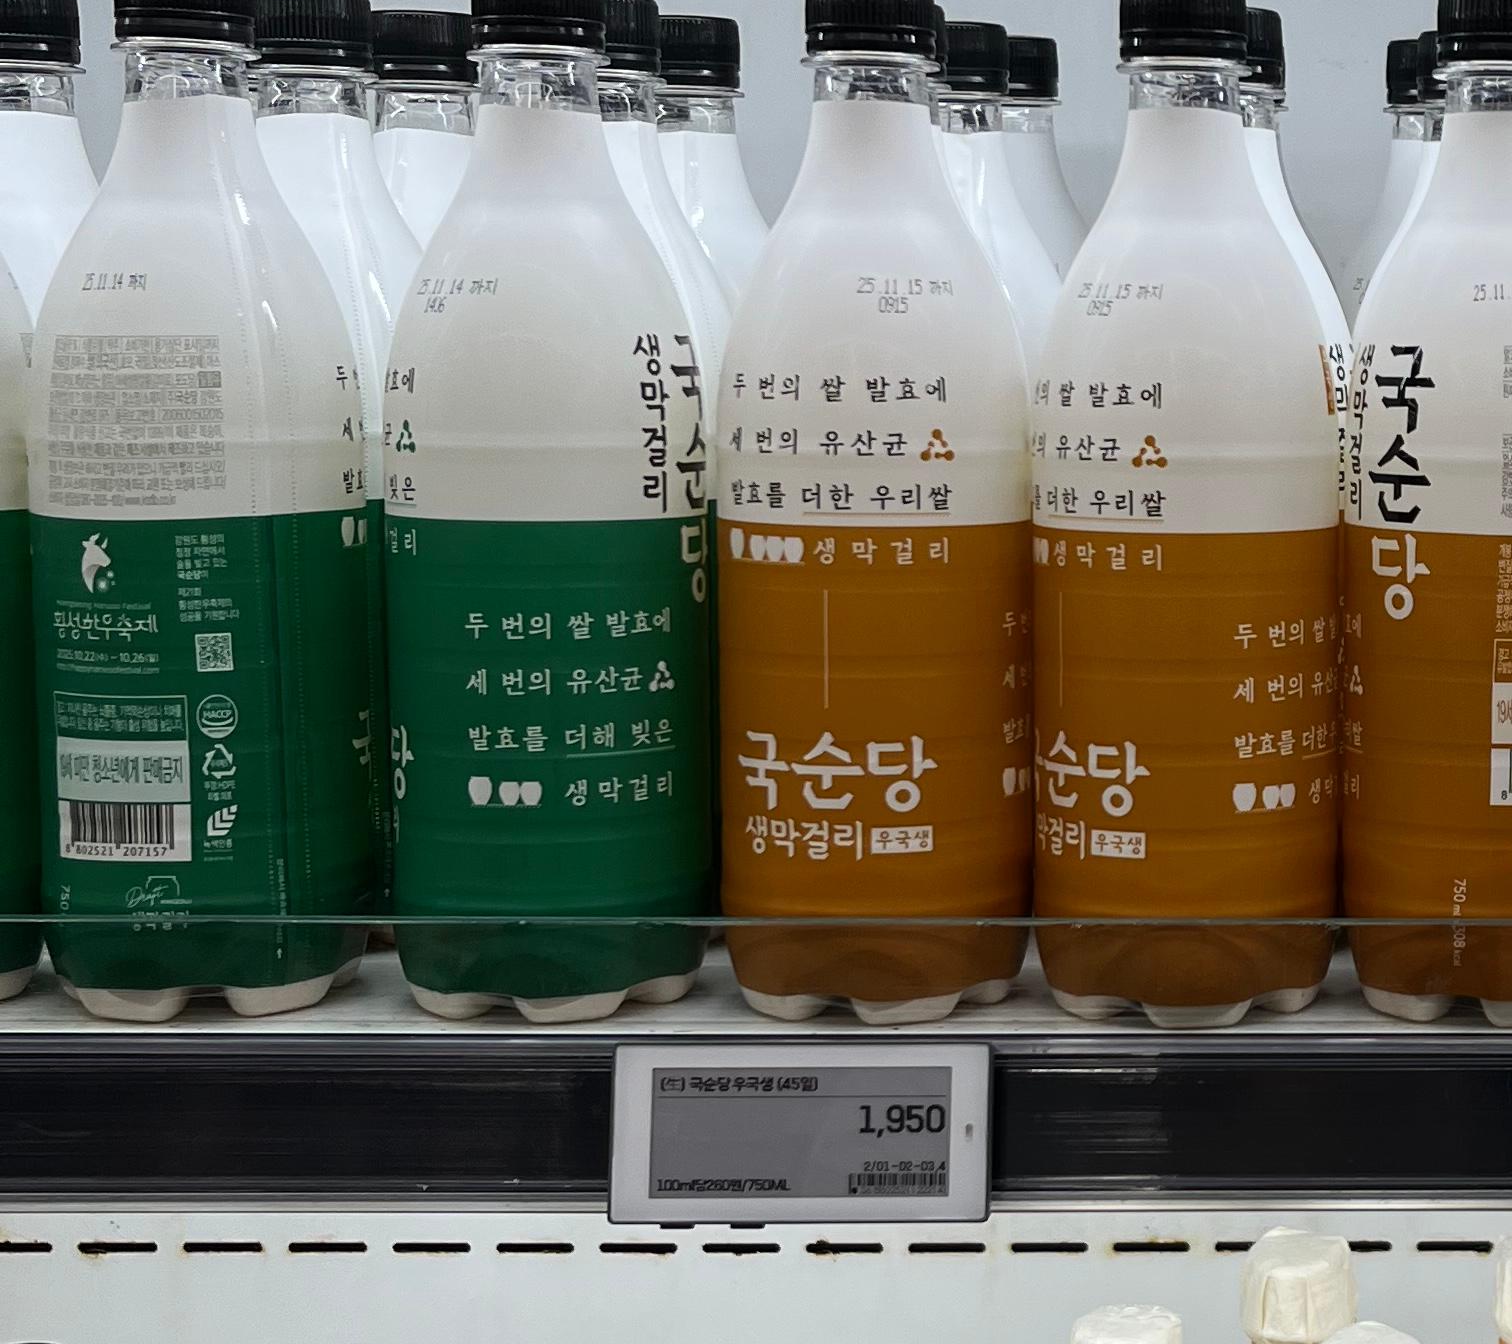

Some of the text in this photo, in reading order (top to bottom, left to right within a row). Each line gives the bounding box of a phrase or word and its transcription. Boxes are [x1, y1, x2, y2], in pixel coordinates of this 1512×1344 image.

[757, 373, 801, 403] 번의
[819, 374, 846, 404] 쌀
[865, 374, 948, 406] 발효에
[632, 332, 670, 514] 생막걸리
[755, 426, 800, 456] 번의
[818, 427, 908, 458] 유산균
[730, 478, 953, 513] 발효를 더한 우리쌀
[1368, 342, 1436, 622] 국순당
[812, 536, 951, 566] 생막걸리
[465, 606, 672, 642] 두 번의 쌀 발효에
[465, 663, 643, 697] 세 번의 유산균
[467, 718, 674, 753] 발효를 더해 빚은
[563, 770, 674, 807] 생막걸리
[738, 730, 938, 814] 국순당
[745, 814, 931, 862] 생막걸리 우국생
[859, 1104, 946, 1138] 1,950
